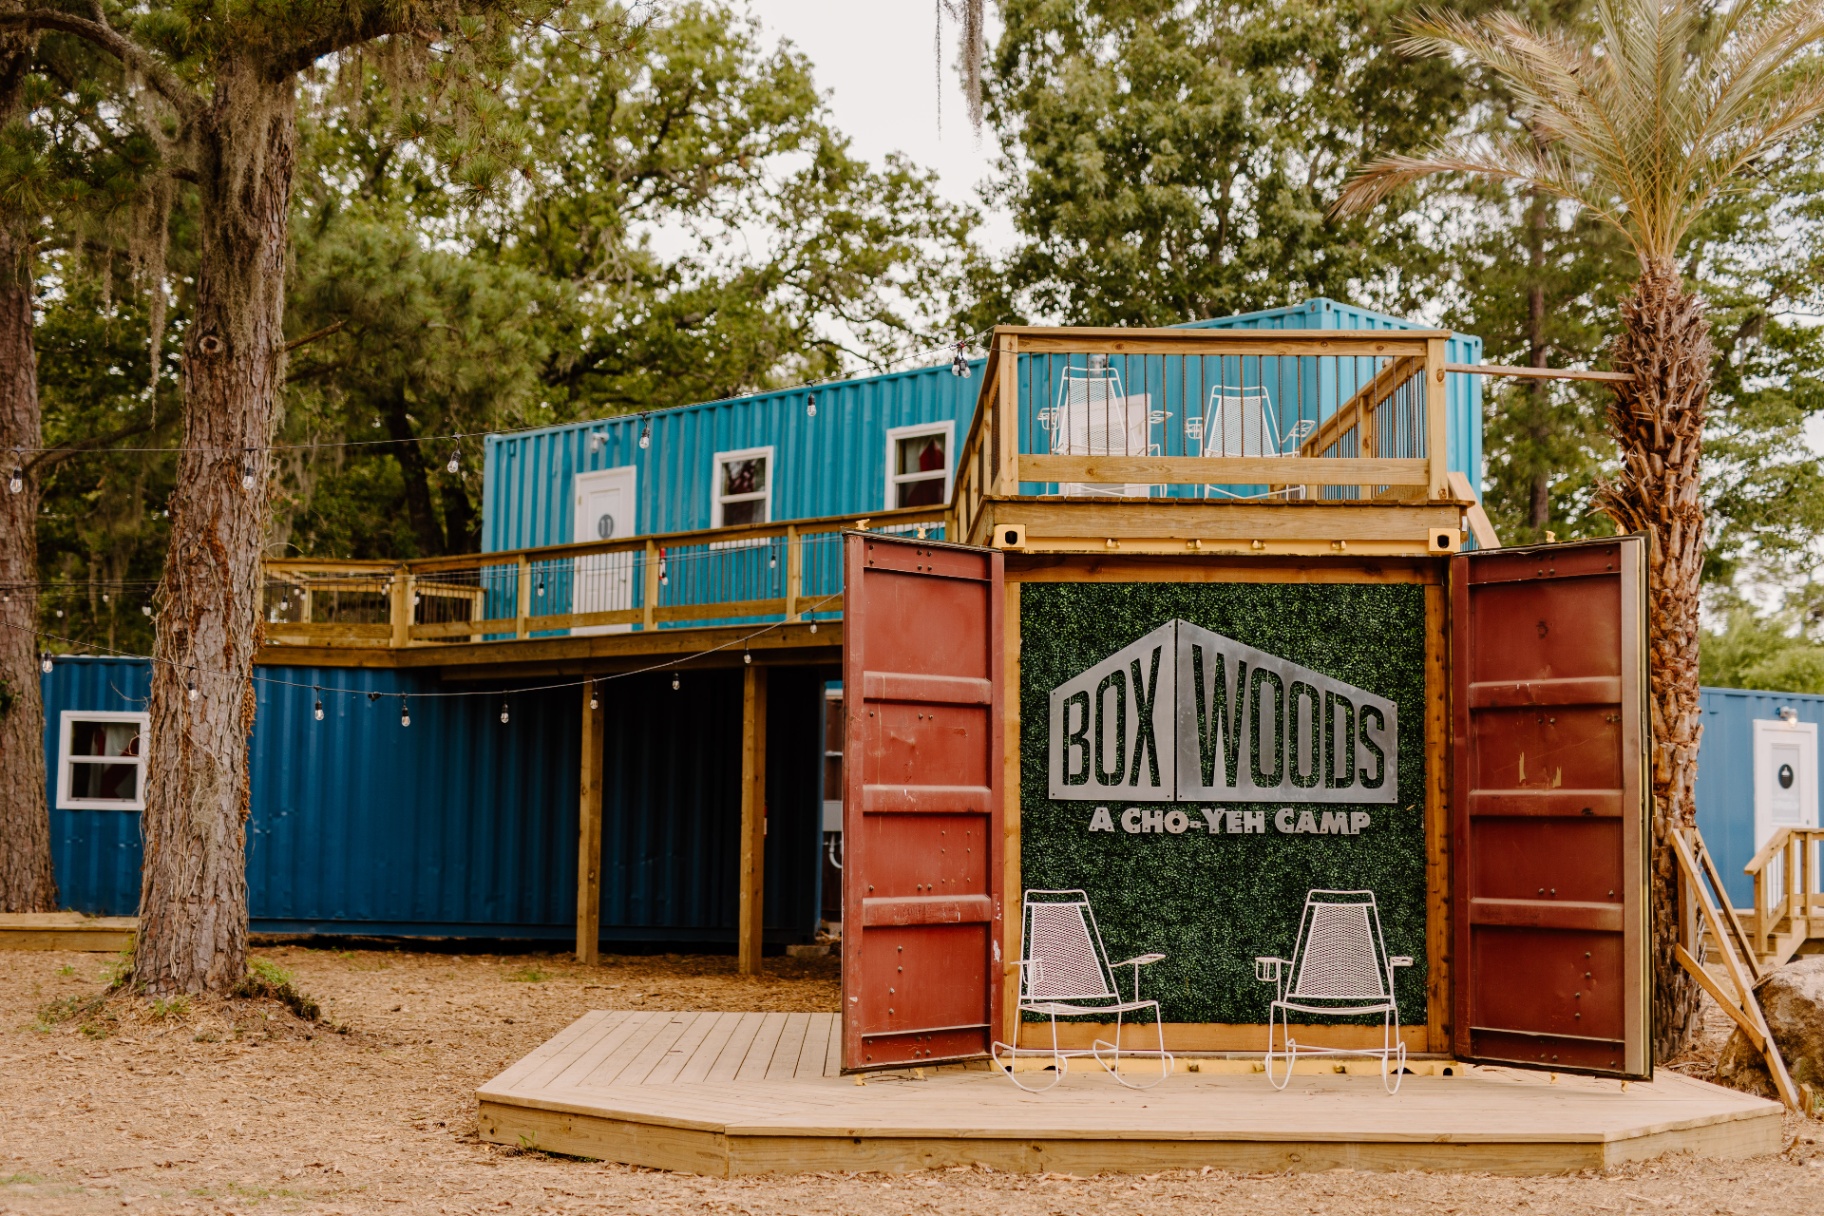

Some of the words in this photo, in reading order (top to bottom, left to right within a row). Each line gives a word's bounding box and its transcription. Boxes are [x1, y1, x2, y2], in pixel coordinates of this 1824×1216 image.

[1062, 644, 1162, 787] BOX
[1191, 643, 1385, 789] WOODS
[1088, 806, 1115, 832] A
[1120, 807, 1266, 834] CHO-YEH
[1274, 807, 1371, 835] CAMP
